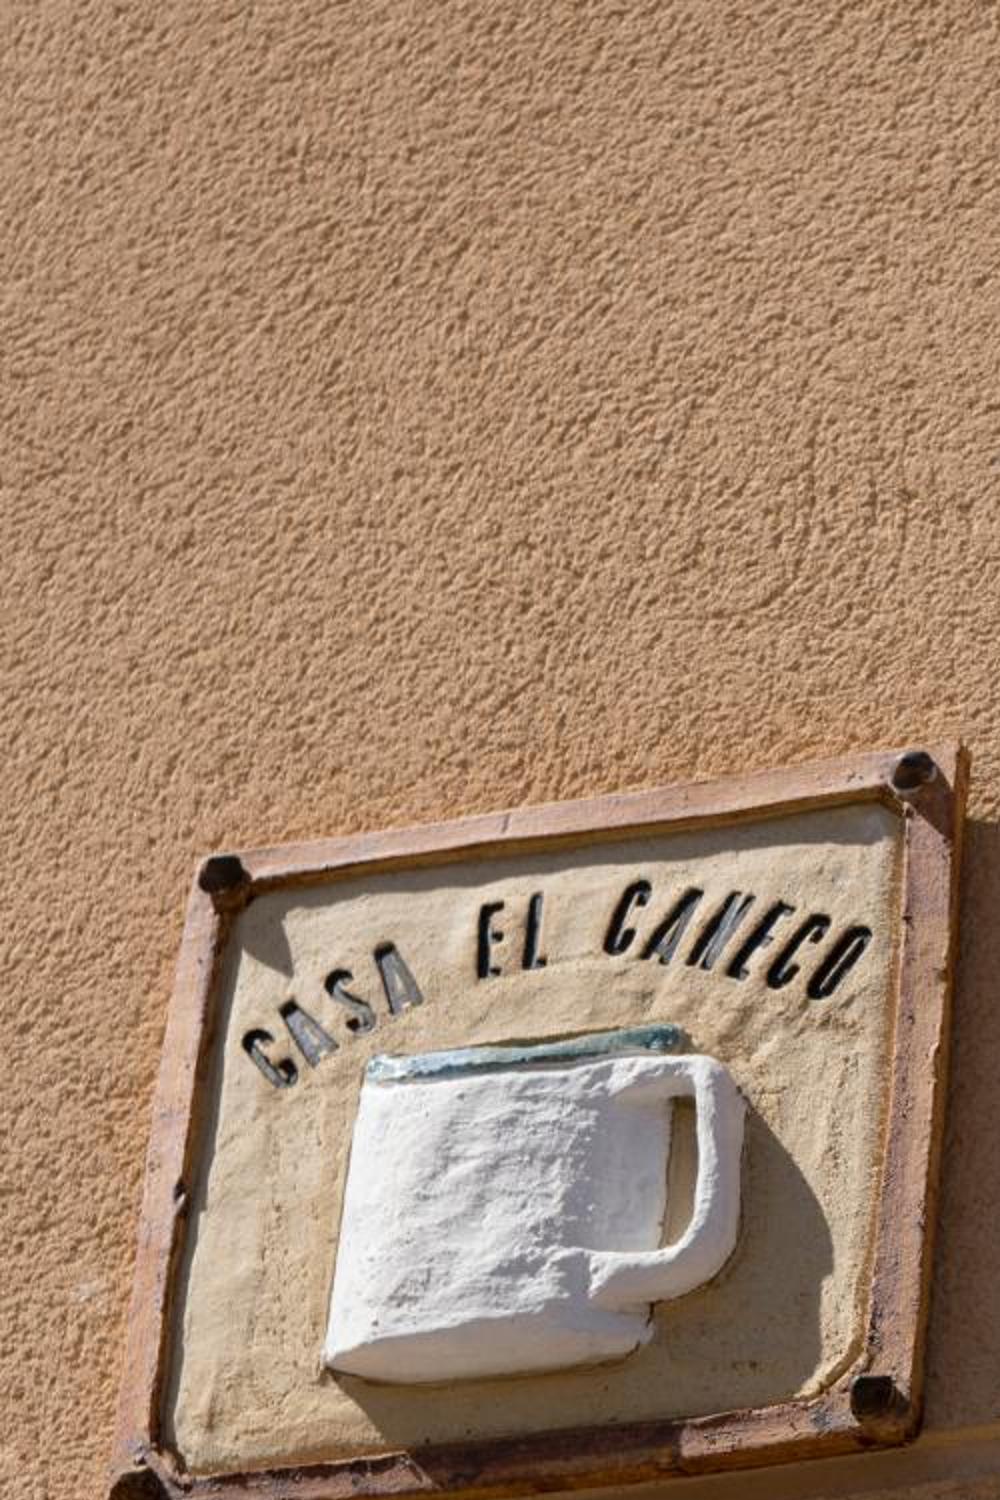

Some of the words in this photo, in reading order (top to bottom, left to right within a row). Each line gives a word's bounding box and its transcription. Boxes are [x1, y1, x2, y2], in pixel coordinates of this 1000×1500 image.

[242, 940, 424, 1088] CASA
[476, 890, 547, 979] EL
[602, 879, 873, 1001] CANECO
